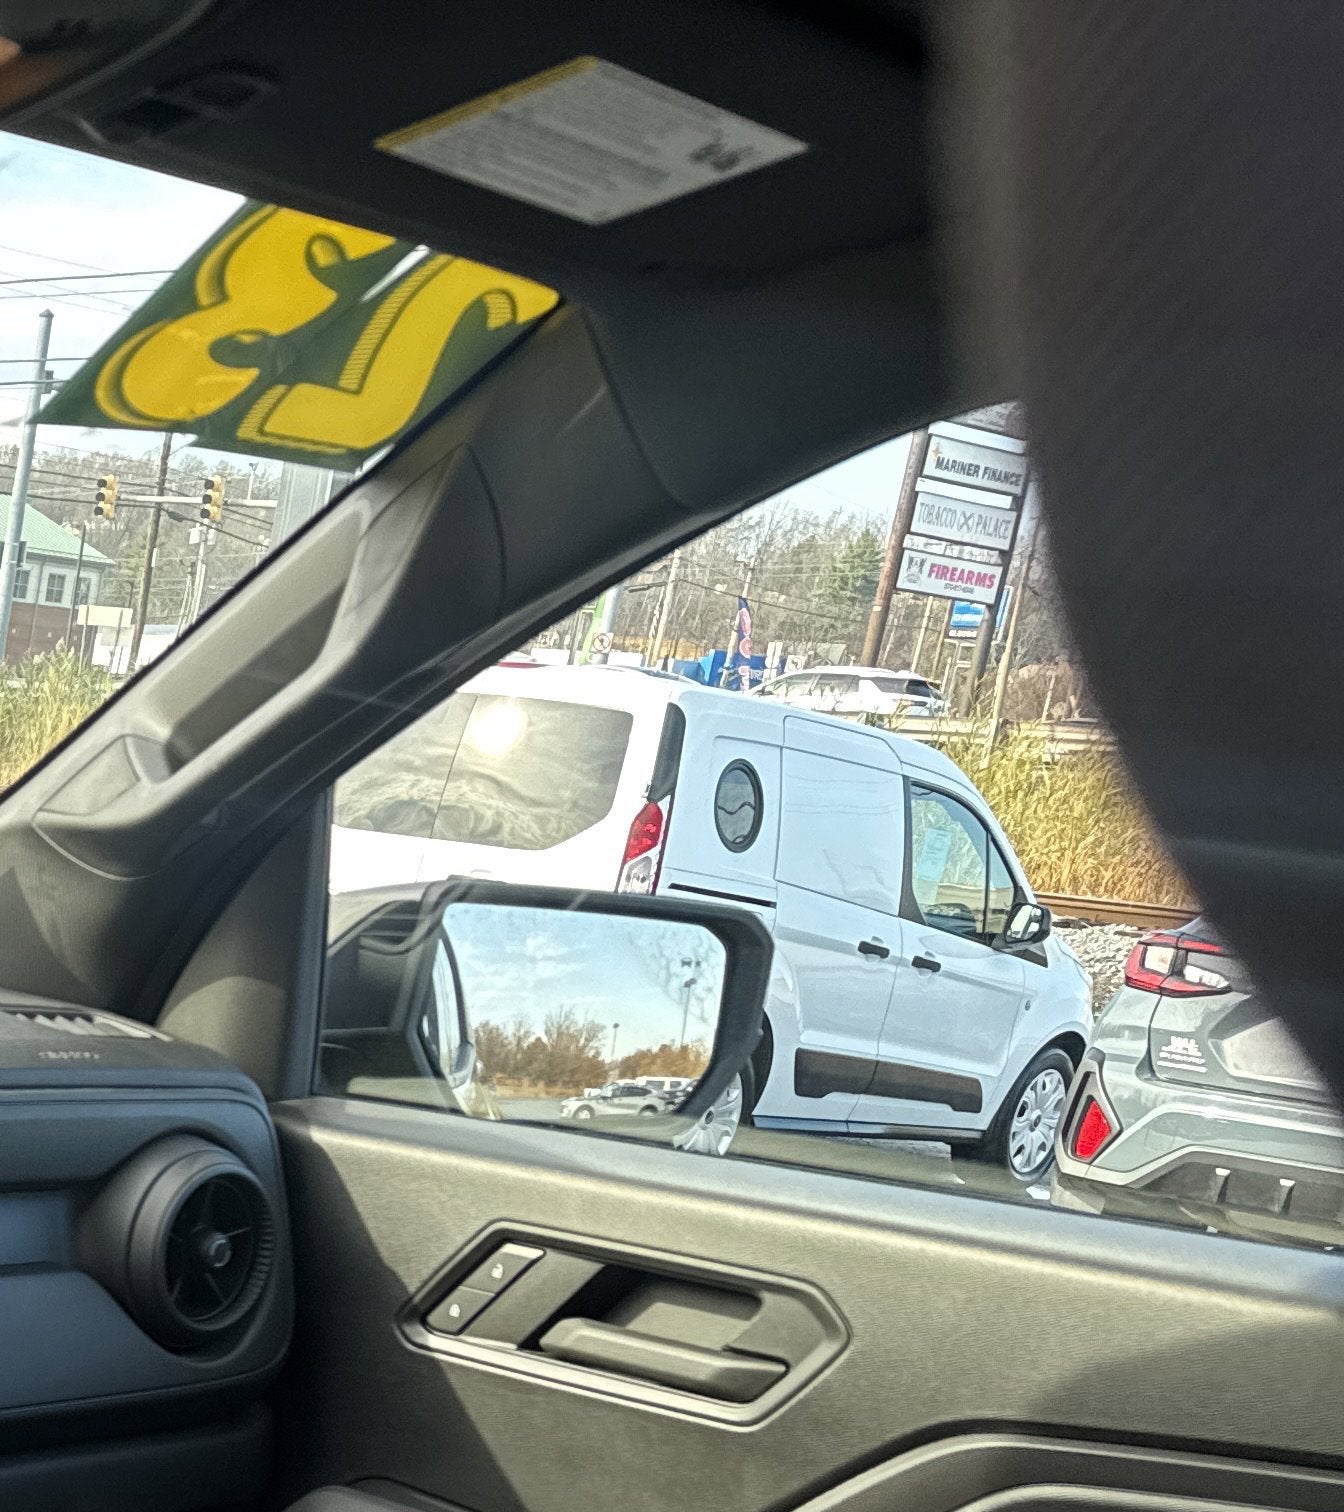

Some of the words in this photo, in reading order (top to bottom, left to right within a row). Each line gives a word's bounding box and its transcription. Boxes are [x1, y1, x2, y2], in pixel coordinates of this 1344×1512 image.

[935, 456, 981, 479] MARINER
[982, 466, 1024, 487] FINANCE
[918, 502, 957, 530] TOBACCO
[975, 514, 1012, 540] PALACE
[928, 563, 997, 589] FIREARMS
